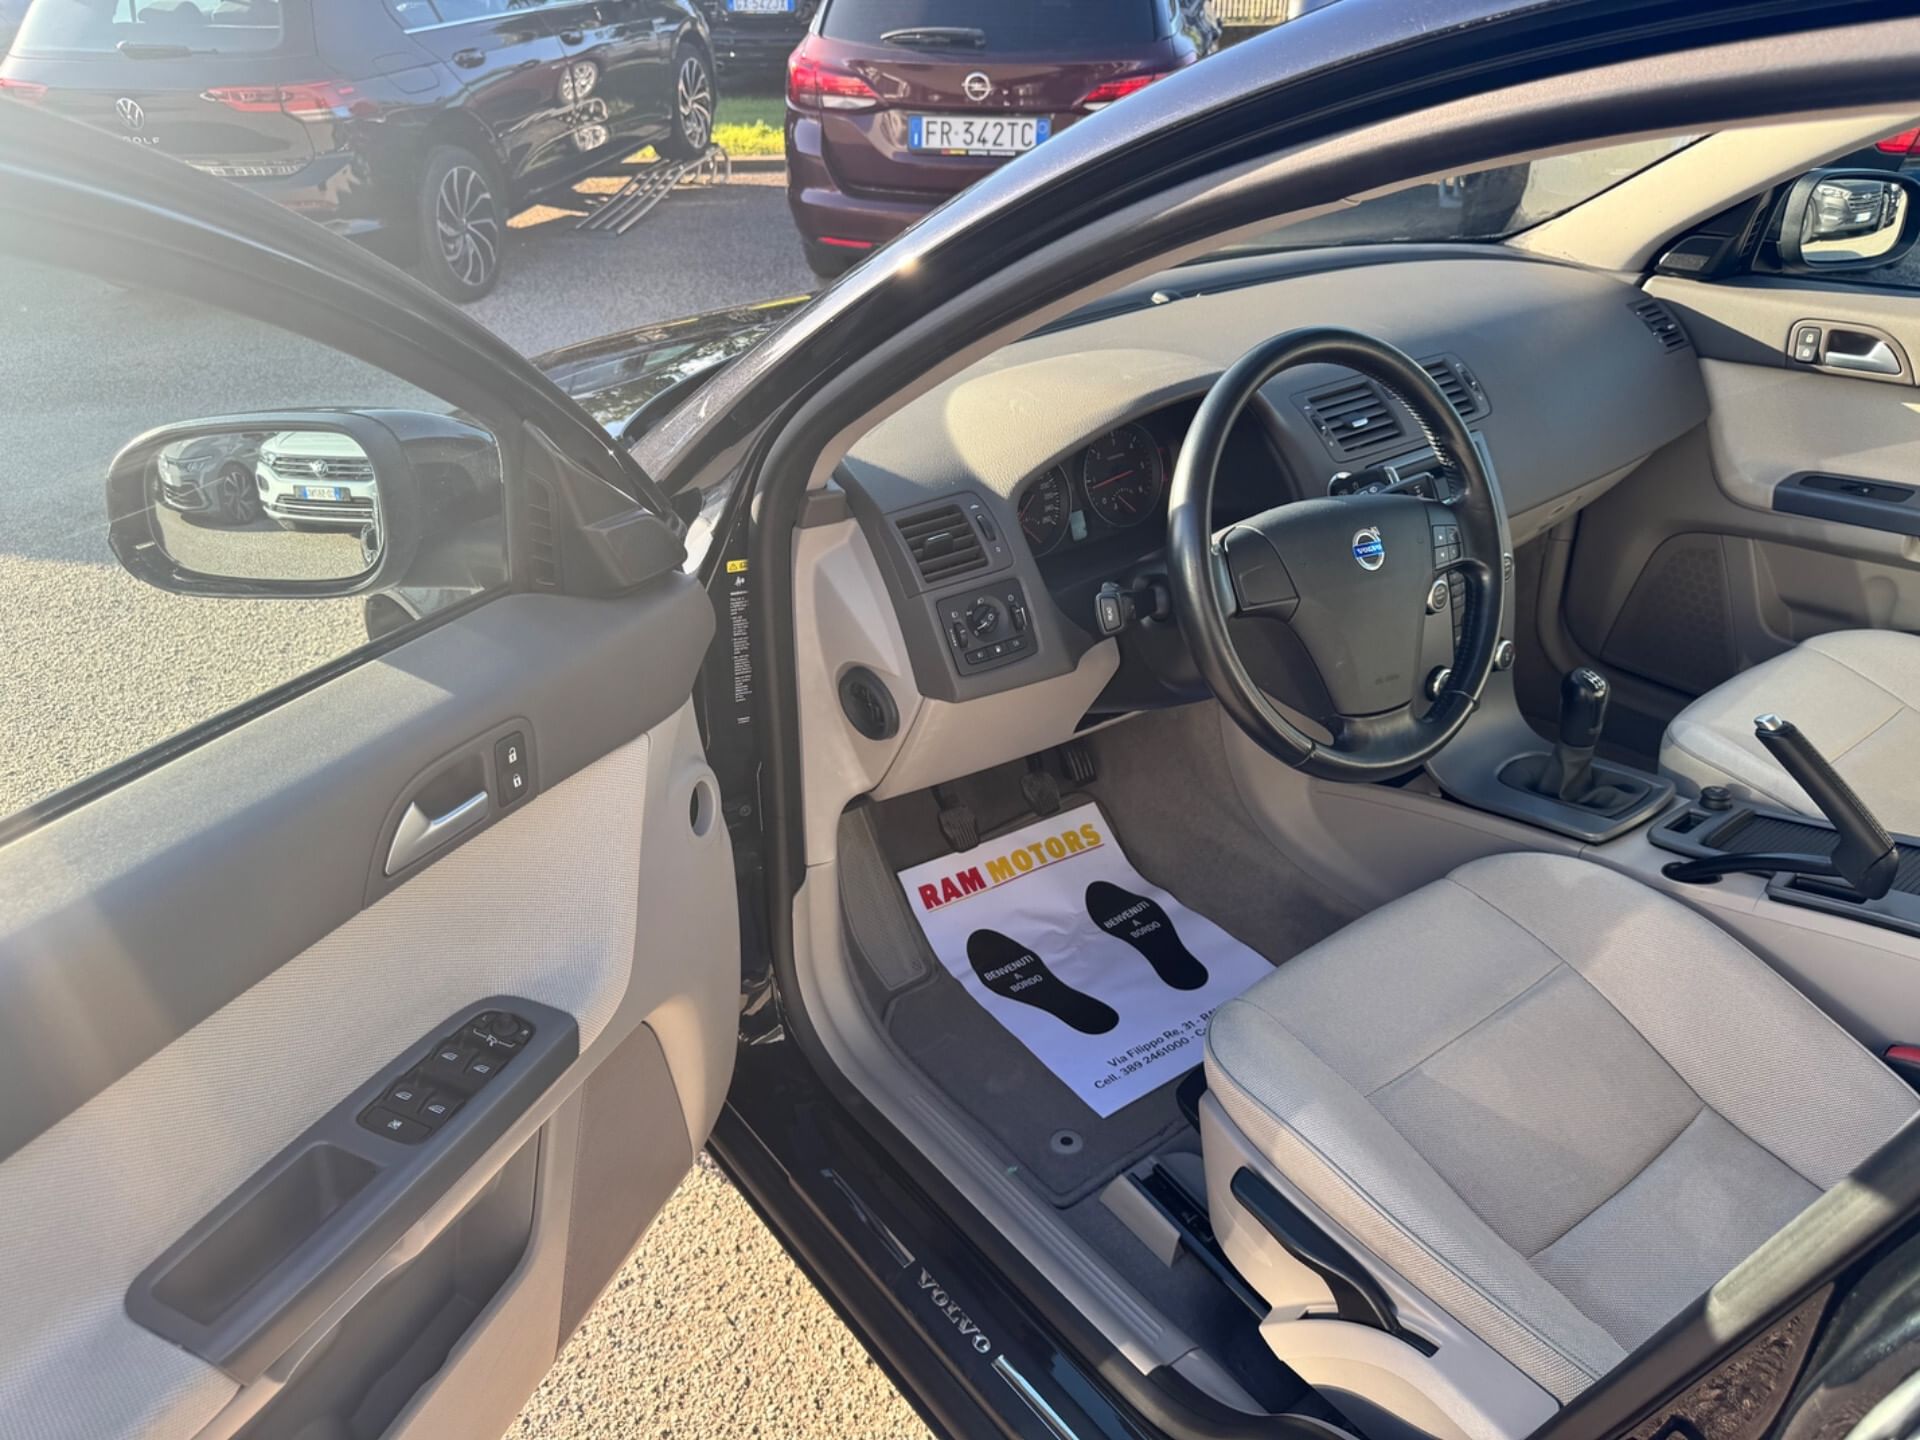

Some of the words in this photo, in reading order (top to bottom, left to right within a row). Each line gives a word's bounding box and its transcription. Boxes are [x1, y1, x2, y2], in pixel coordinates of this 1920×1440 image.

[1356, 543, 1382, 555] VOLVO
[918, 867, 987, 910] RAM
[985, 824, 1102, 884] MOTORS
[1103, 900, 1150, 929] BENVENUTI
[1132, 919, 1142, 927] A
[1130, 920, 1161, 938] BORDO
[984, 955, 1034, 981] BENVENUTI
[1009, 974, 1043, 992] BORDO
[1107, 1054, 1128, 1067] Via
[1126, 1036, 1164, 1058] Filippo
[1162, 1028, 1184, 1041] Re,
[1182, 1019, 1195, 1030] 31
[1094, 1073, 1121, 1089] Cell.
[1120, 1061, 1143, 1076] 389
[1142, 1037, 1190, 1065] 2461000
[915, 1266, 992, 1354] VOLVO
